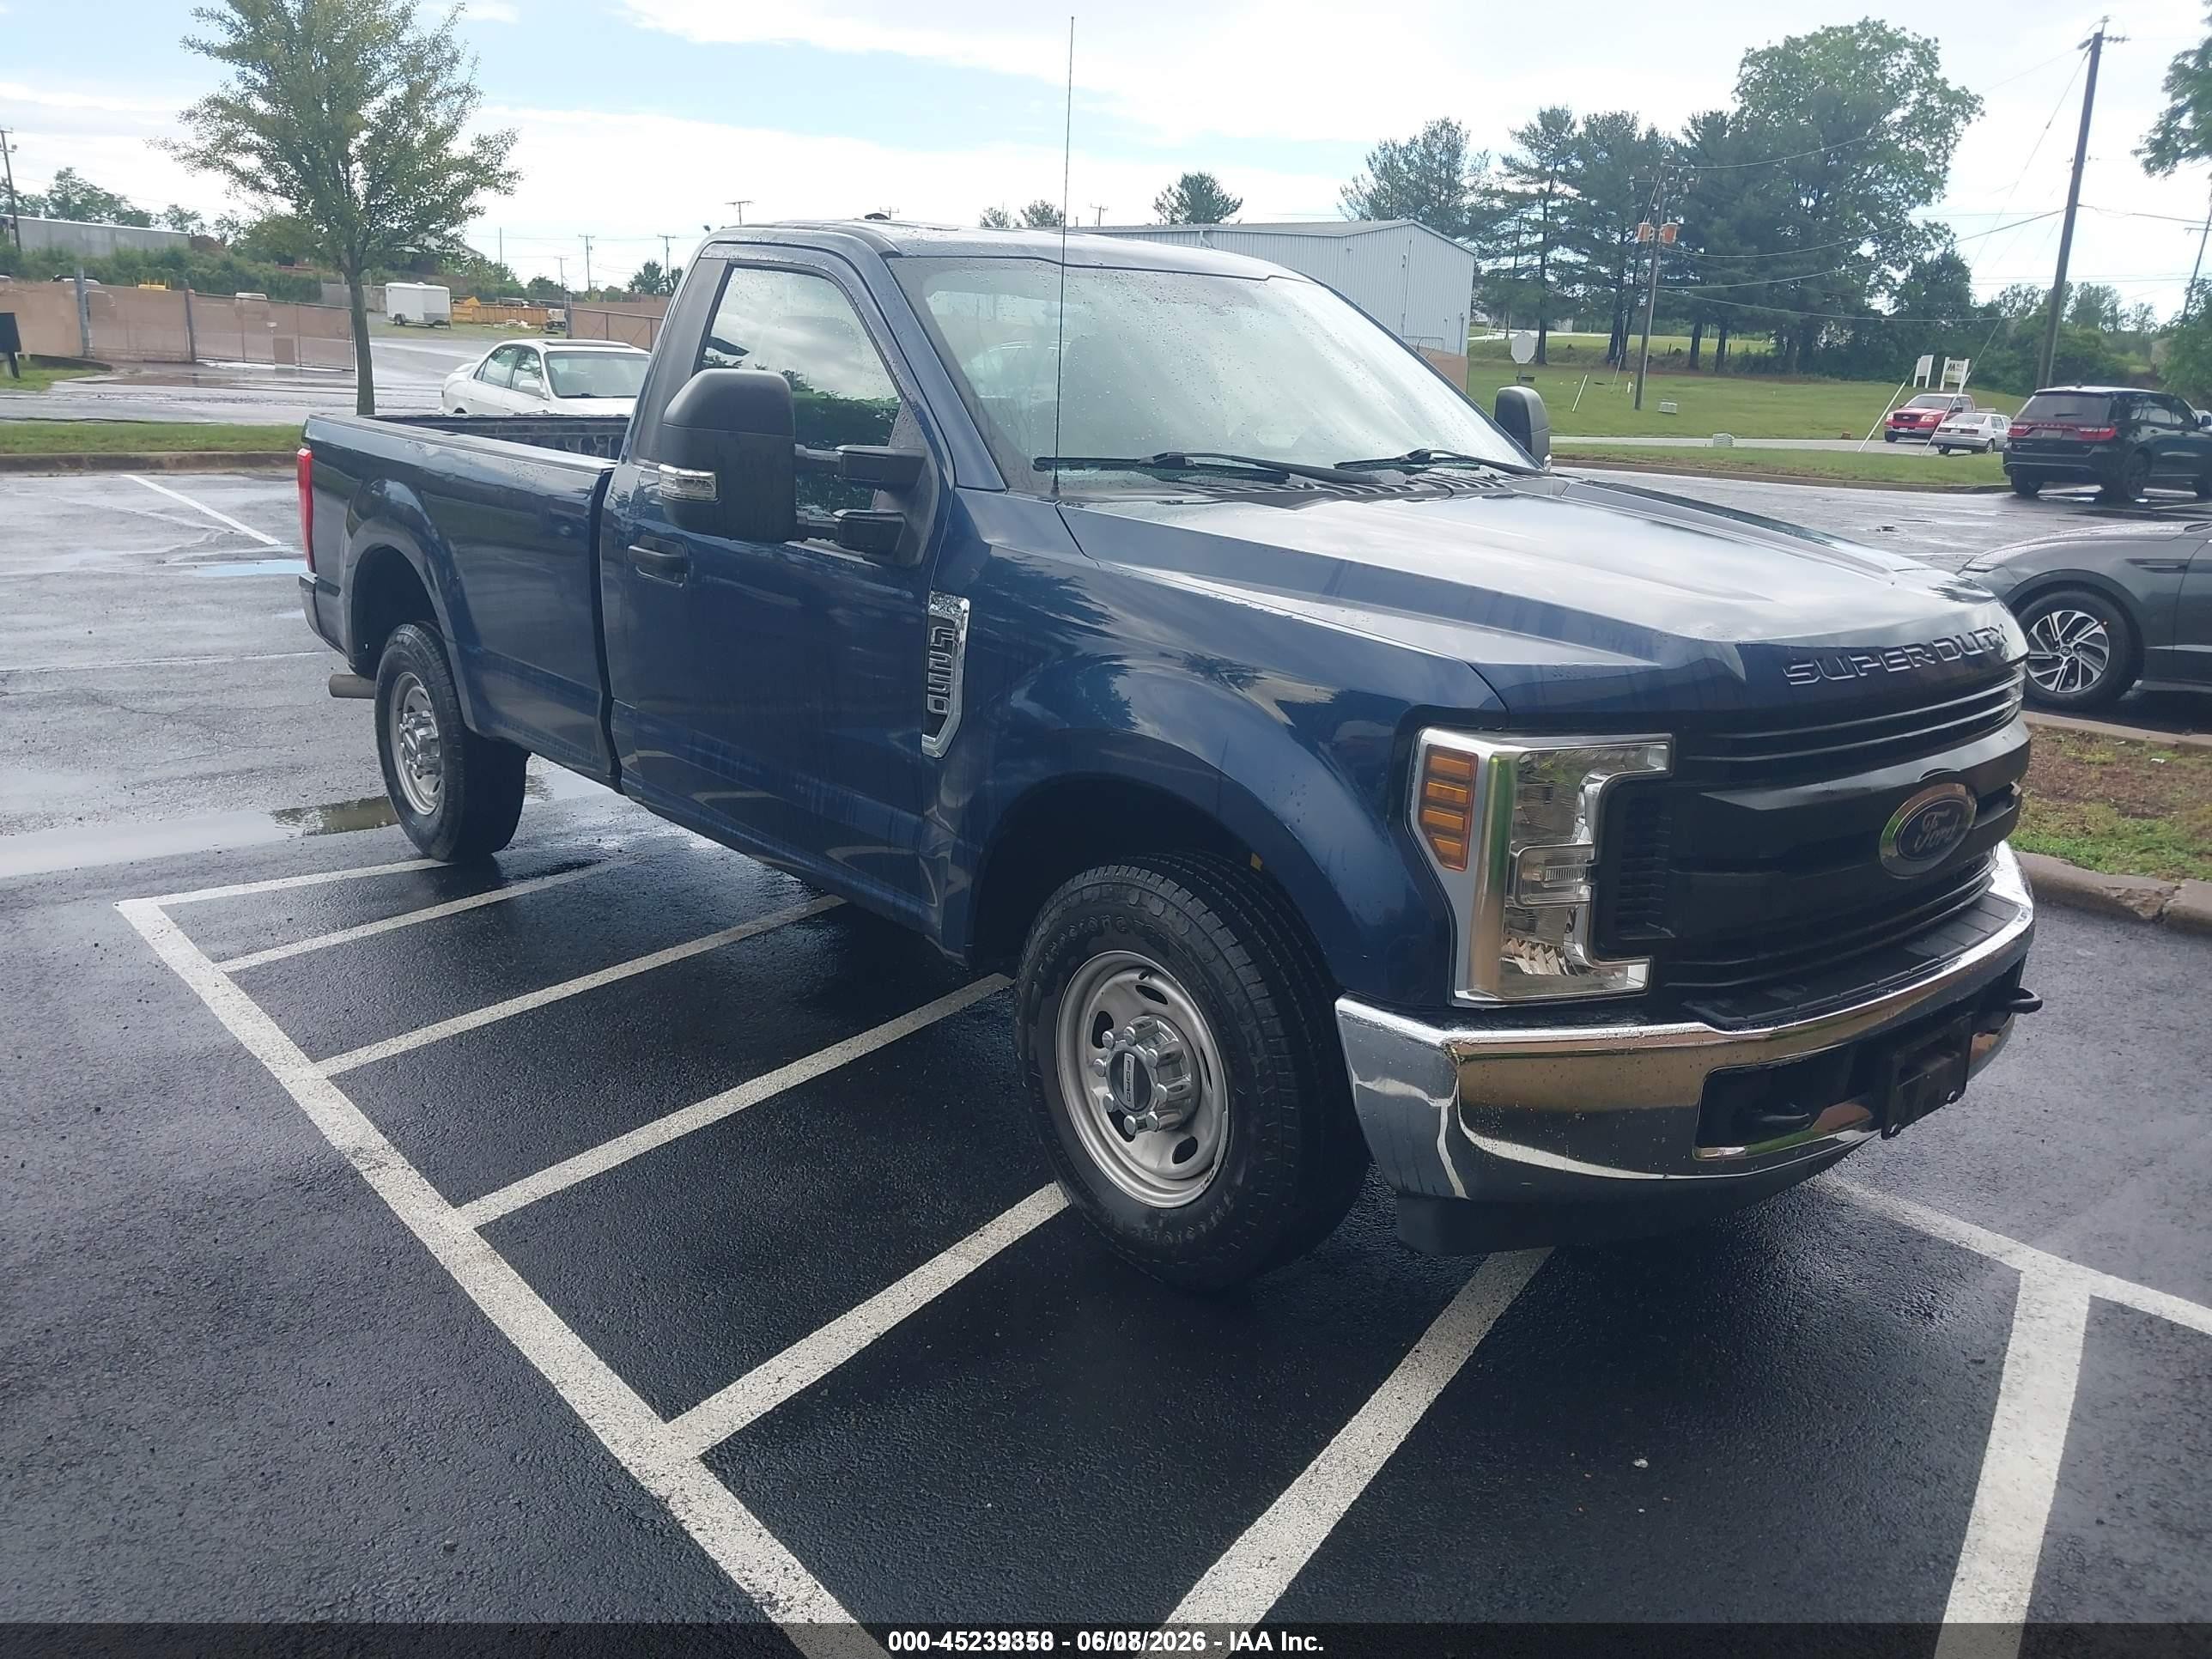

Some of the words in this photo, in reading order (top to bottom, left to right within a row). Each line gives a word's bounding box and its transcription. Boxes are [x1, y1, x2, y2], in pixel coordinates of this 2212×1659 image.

[1782, 644, 1934, 685] SUPER
[1932, 623, 2008, 661] DUTY
[1914, 809, 1960, 853] Ford
